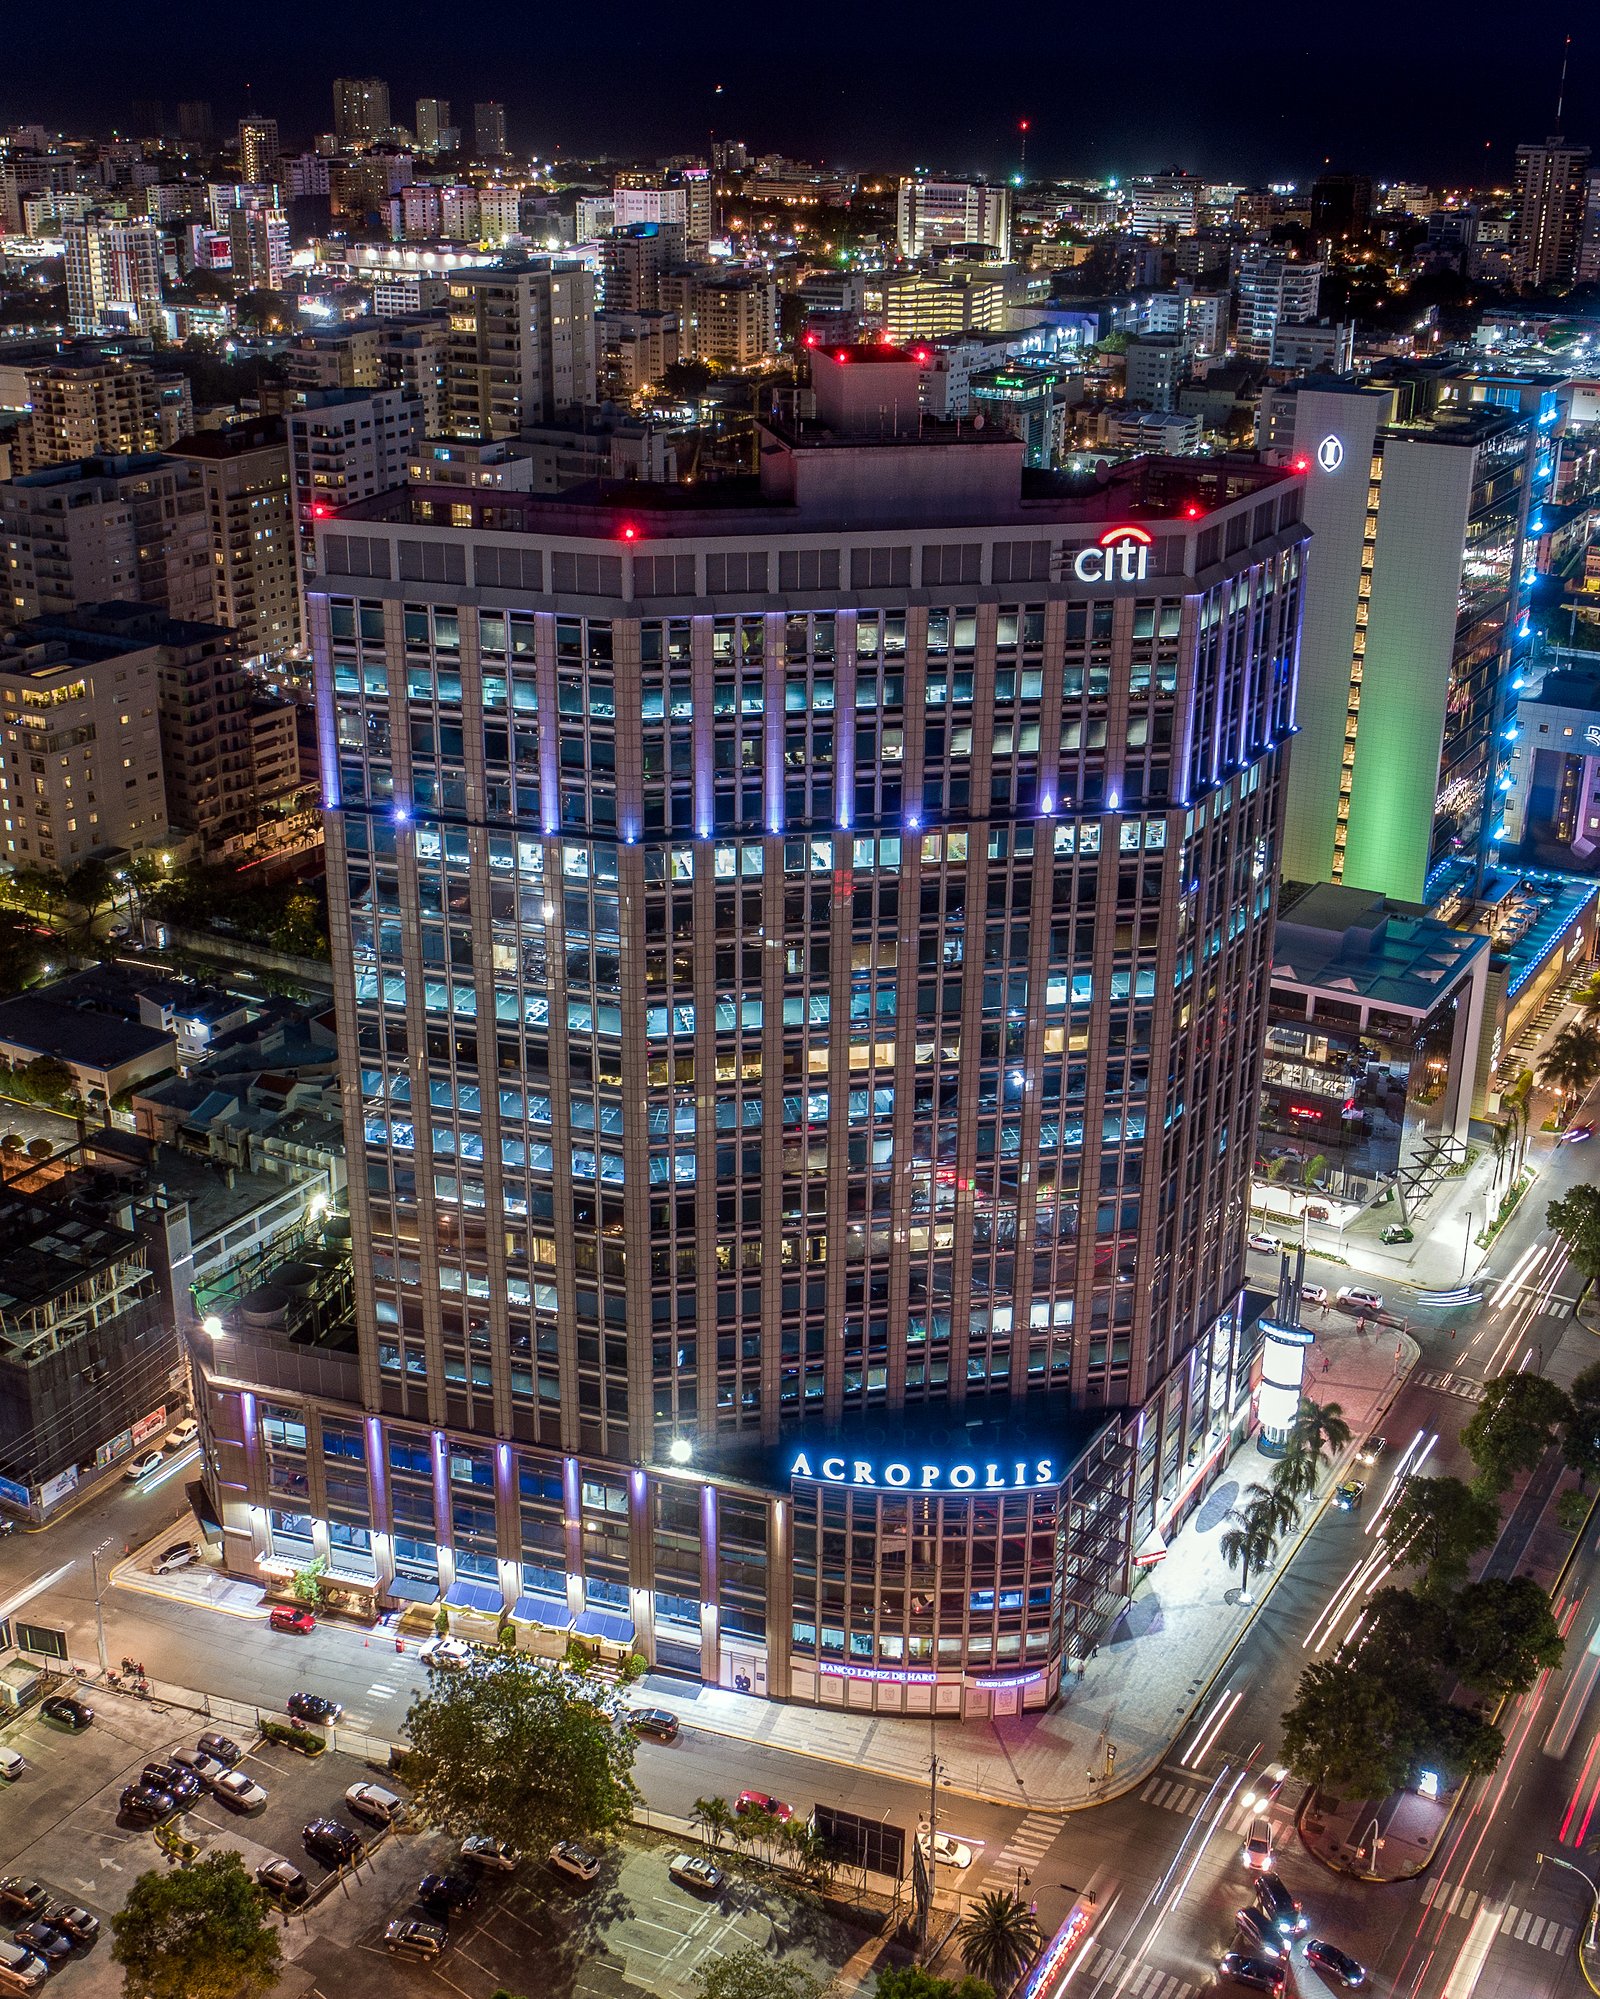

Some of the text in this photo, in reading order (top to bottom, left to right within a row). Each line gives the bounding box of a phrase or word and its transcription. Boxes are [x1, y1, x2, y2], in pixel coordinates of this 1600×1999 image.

[1074, 537, 1148, 582] citi
[790, 1452, 1053, 1488] ACROPOLIS
[820, 1663, 937, 1682] BANCO LOPEZ DE HARO
